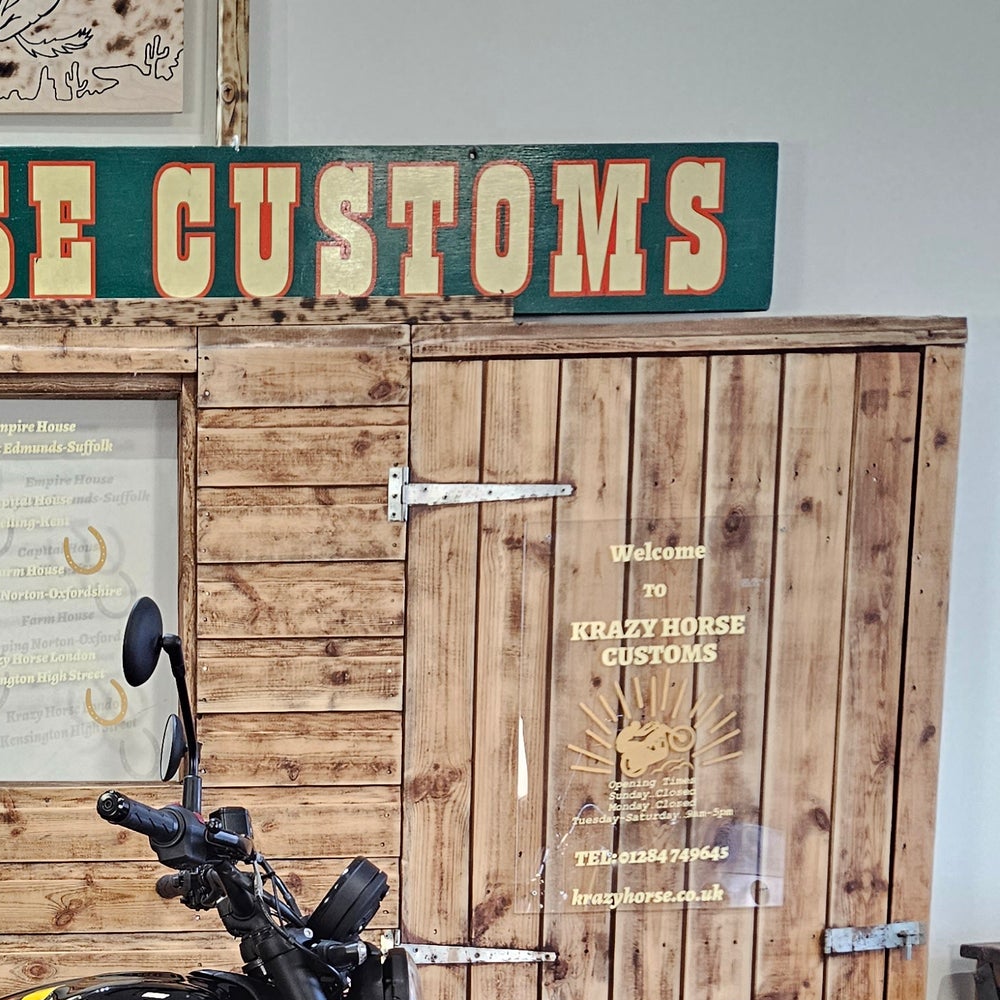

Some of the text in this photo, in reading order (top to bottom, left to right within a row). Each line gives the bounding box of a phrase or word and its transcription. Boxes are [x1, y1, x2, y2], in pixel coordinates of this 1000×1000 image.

[152, 157, 727, 299] CUSTOMS
[36, 420, 77, 433] House
[3, 438, 113, 456] Edmunds-Suffolk
[34, 493, 74, 506] House
[610, 542, 708, 563] Welcome
[26, 564, 65, 577] House
[0, 585, 123, 601] Norton-Oxfordshire
[642, 583, 668, 598] TO
[570, 615, 746, 641] KRAZY HORSE
[12, 652, 49, 665] Horse
[50, 651, 96, 664] London
[602, 643, 718, 666] CUSTOMS
[36, 670, 68, 686] High
[69, 669, 106, 681] Street
[608, 777, 697, 791] Opening Times
[571, 883, 725, 910] krazyhorse.co.uk
